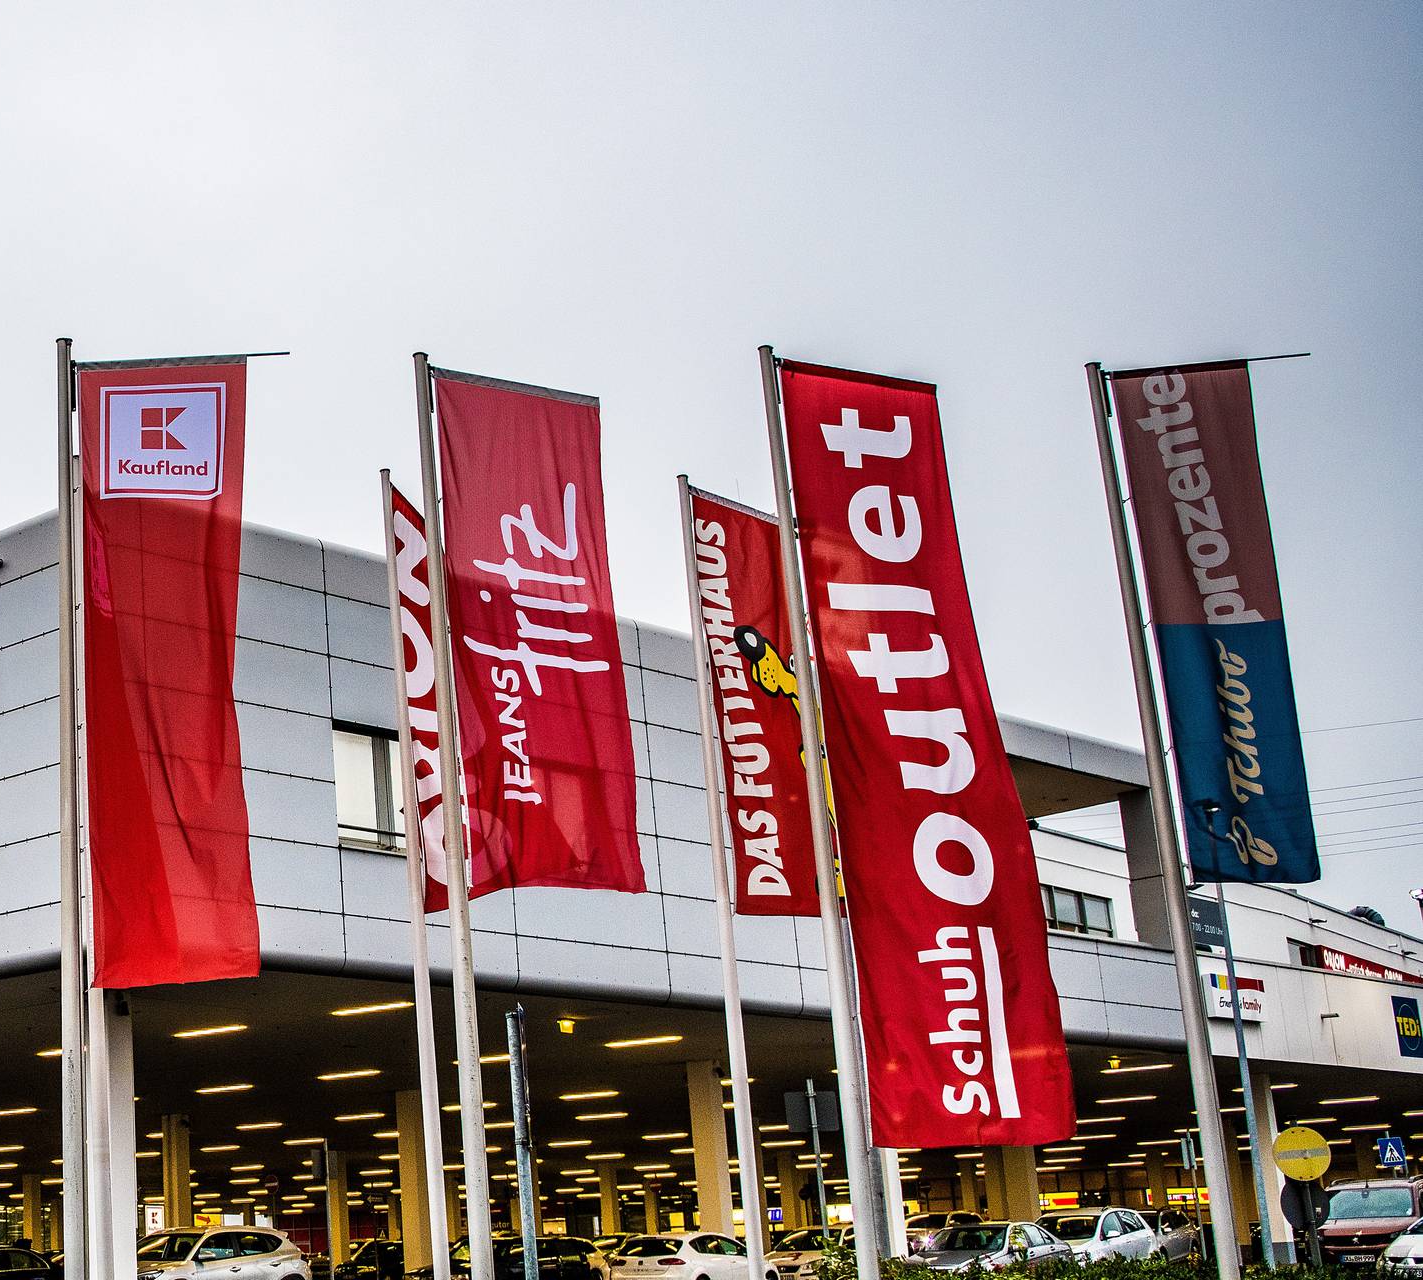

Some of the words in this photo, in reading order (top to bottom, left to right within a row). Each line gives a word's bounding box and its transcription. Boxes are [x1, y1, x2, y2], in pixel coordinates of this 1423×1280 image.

[118, 459, 208, 477] Kaufland
[1136, 369, 1266, 625] prozente
[464, 483, 610, 697] fritz
[696, 518, 774, 798] FUTTERHAUS
[820, 408, 995, 907] outlet
[491, 665, 542, 805] JEANS
[1215, 638, 1265, 804] Tchibo
[746, 809, 792, 897] DAS
[918, 926, 991, 1116] Schuh
[1323, 949, 1346, 972] ORION
[1396, 1016, 1422, 1037] TEDi
